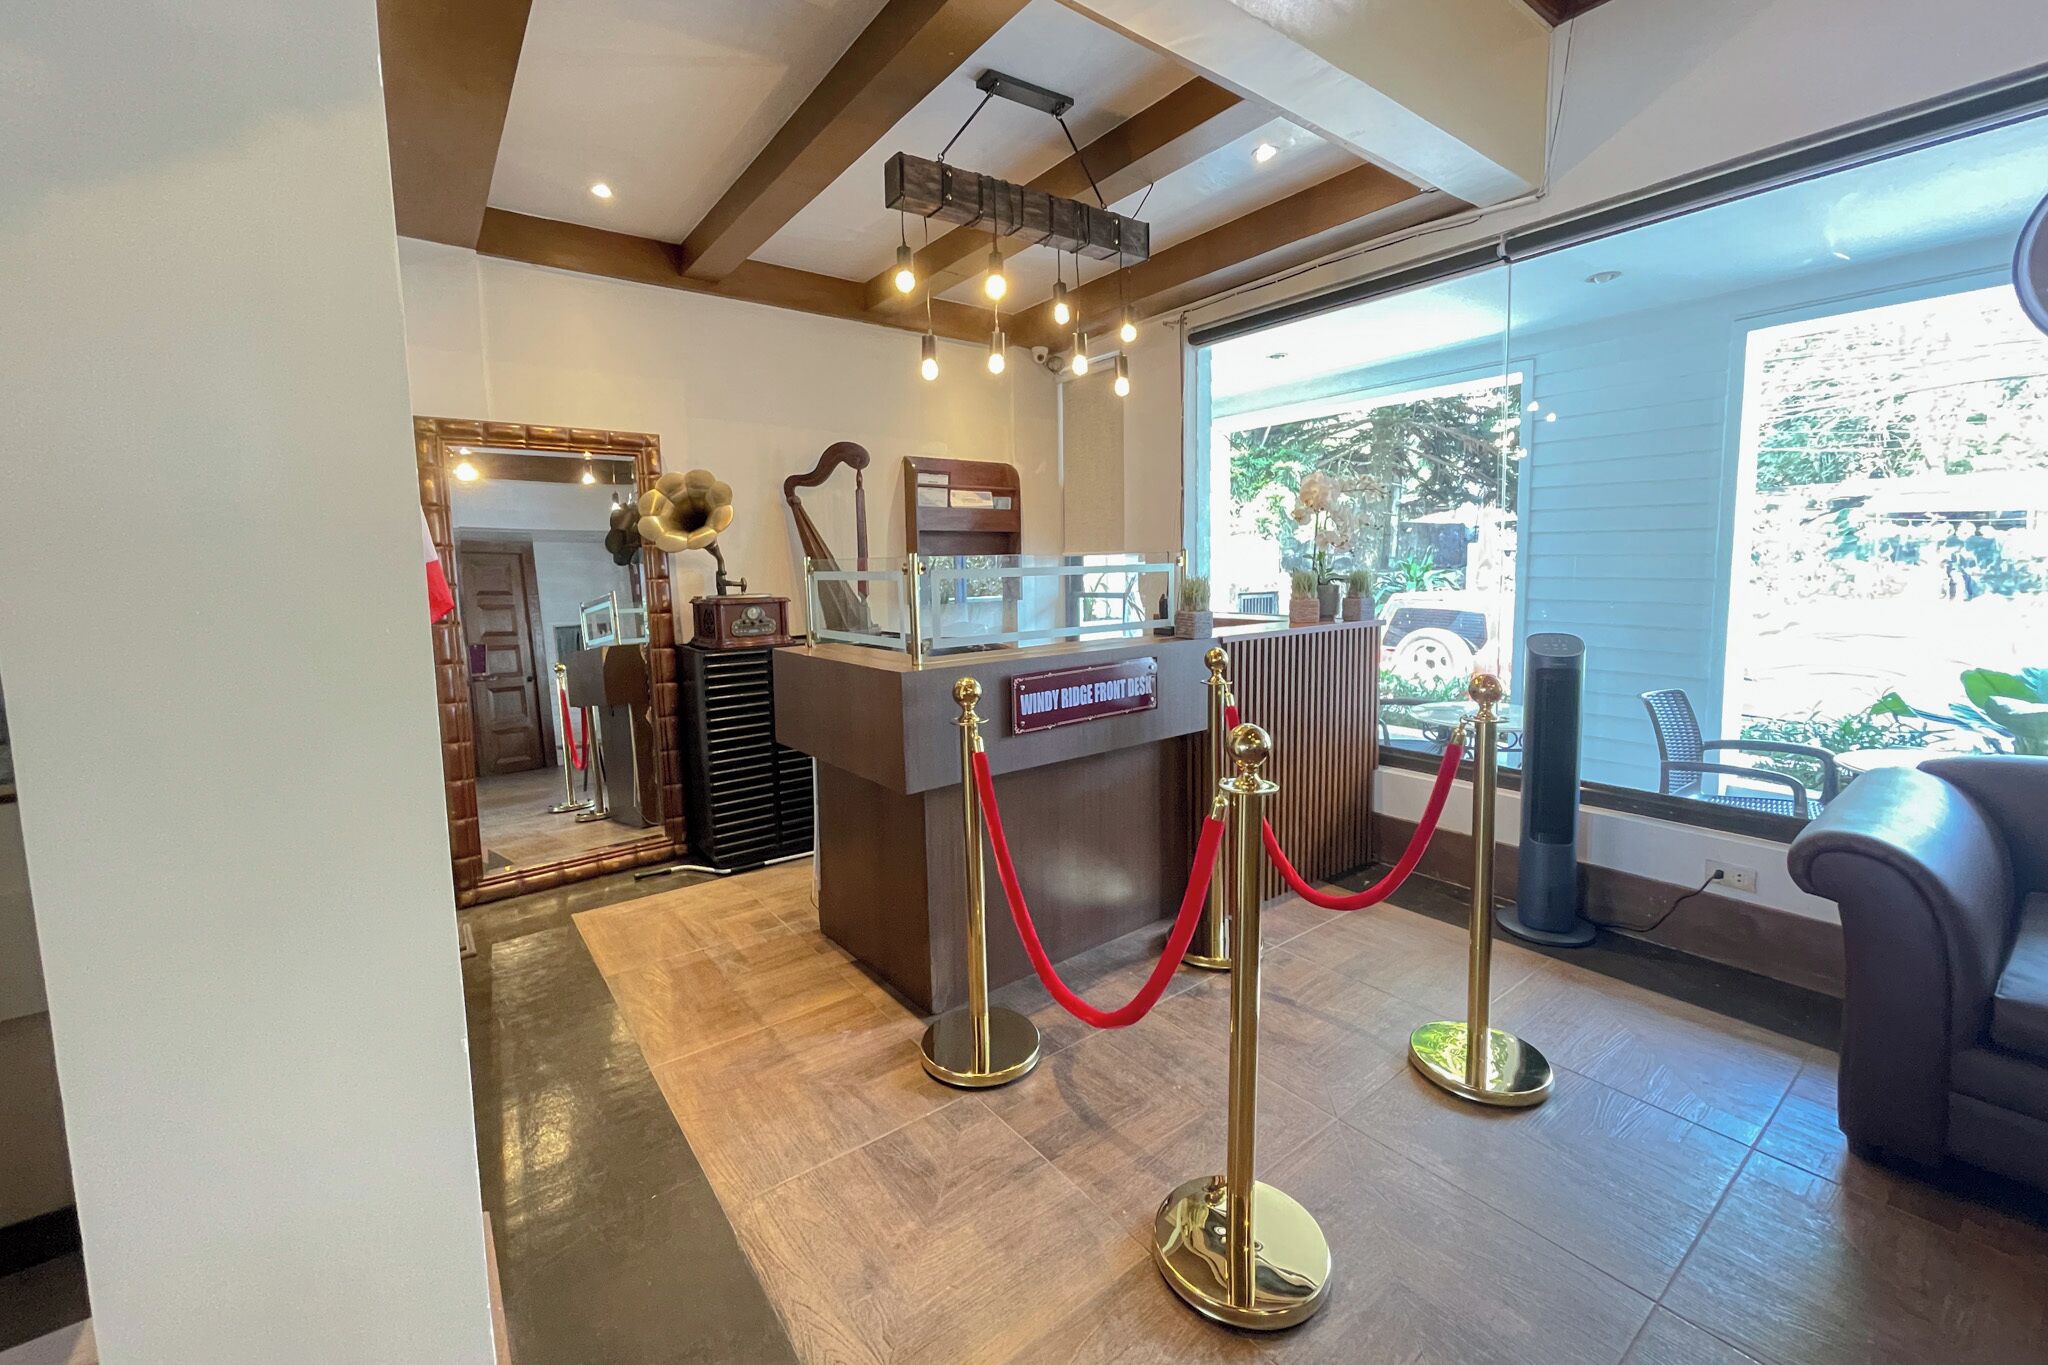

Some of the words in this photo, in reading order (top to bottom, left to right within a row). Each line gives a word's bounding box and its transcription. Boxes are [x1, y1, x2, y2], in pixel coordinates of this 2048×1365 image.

[1020, 689, 1060, 716] WINDY
[1061, 683, 1094, 708] RIDGE
[1094, 679, 1126, 703] FRONT
[1127, 675, 1153, 697] DESK
